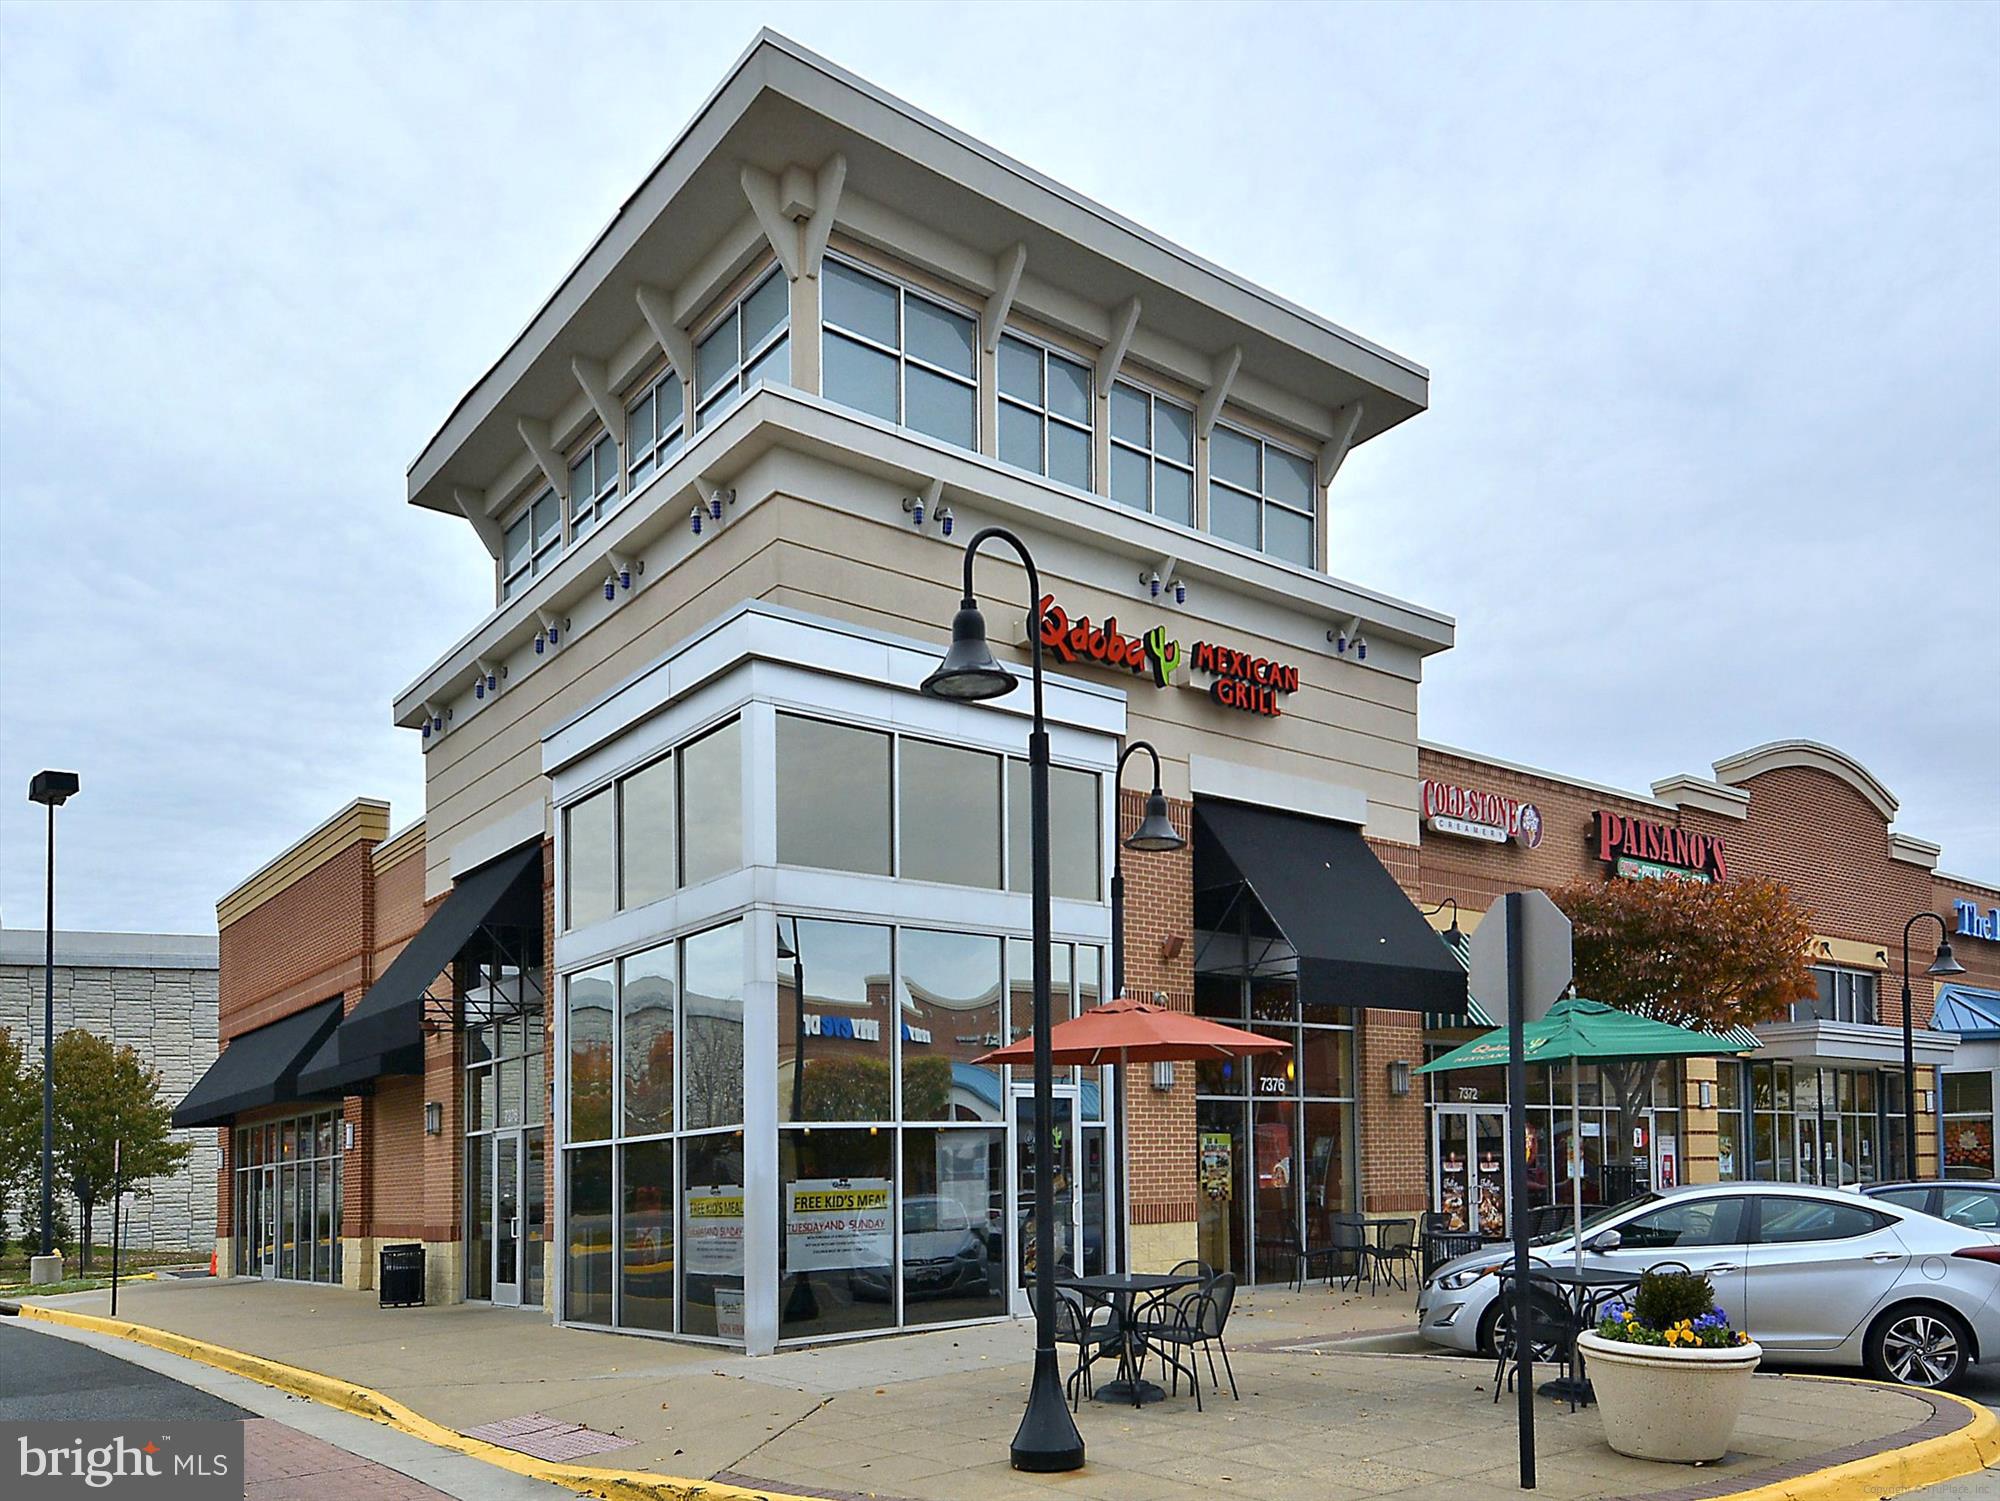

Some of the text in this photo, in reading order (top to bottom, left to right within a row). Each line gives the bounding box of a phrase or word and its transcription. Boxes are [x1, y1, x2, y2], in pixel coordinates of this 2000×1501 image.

[1027, 594, 1146, 673] Qdoba
[1192, 641, 1299, 694] MEXICAN
[1213, 678, 1281, 717] GRILL
[1422, 778, 1520, 837] COLD STONE
[1438, 818, 1505, 840] CREAMERY
[1594, 810, 1727, 882] PAISANO'S
[1952, 897, 1992, 941] The
[1260, 1077, 1285, 1092] 7376
[1458, 1087, 1478, 1101] 7372
[794, 1195, 822, 1209] FREE
[825, 1194, 854, 1209] KID'S
[849, 1218, 886, 1231] SUNDAY
